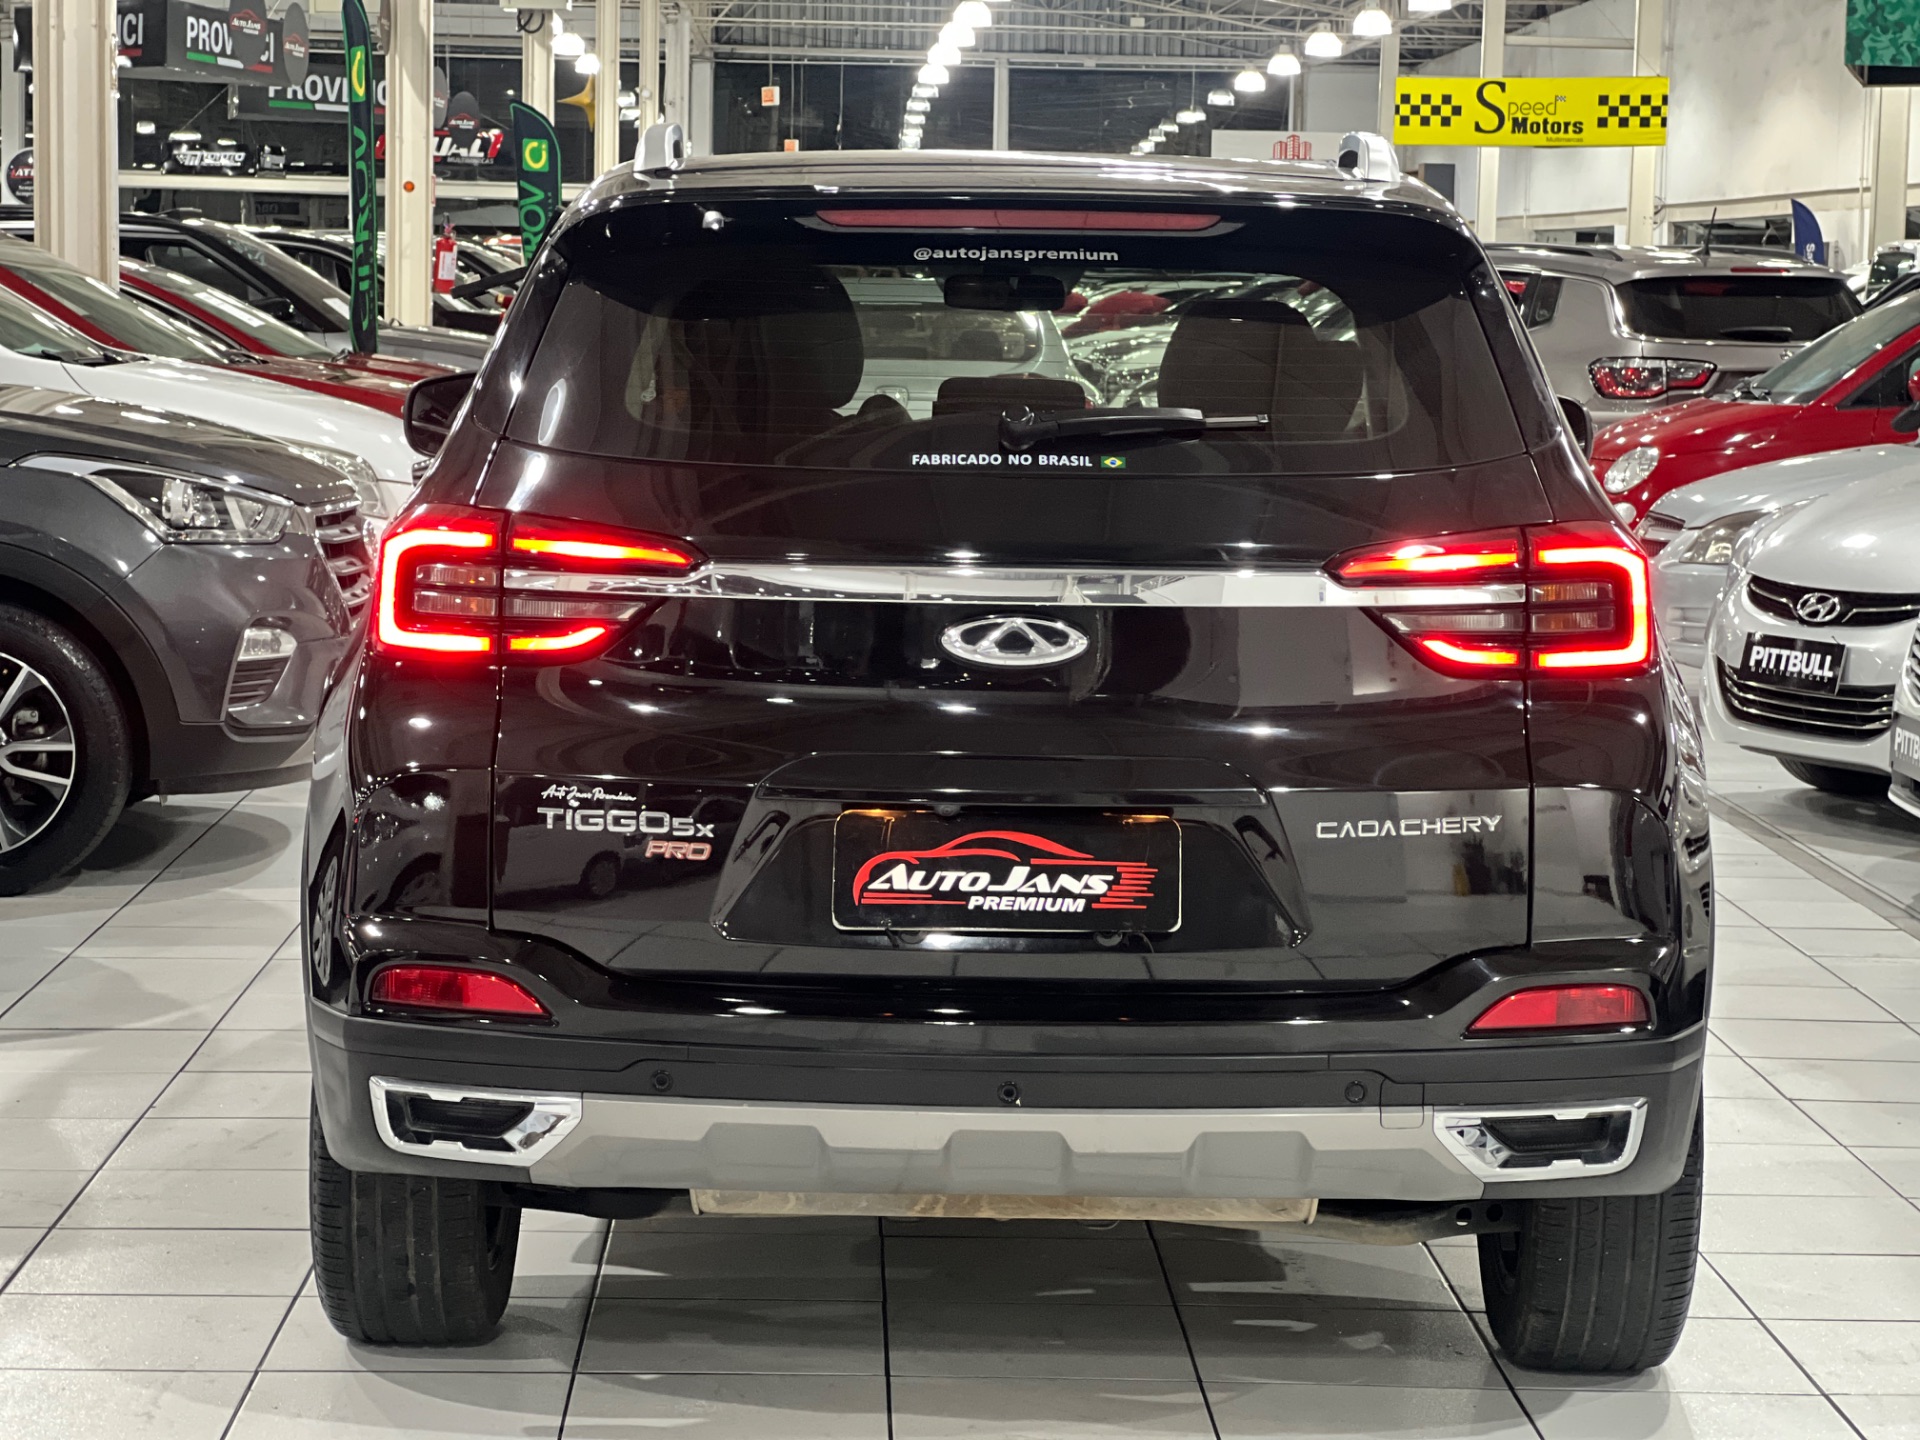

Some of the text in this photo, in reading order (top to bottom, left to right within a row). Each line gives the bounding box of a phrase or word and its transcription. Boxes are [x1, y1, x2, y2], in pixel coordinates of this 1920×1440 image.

[1474, 81, 1558, 134] Speed
[1511, 117, 1584, 135] Motors
[913, 247, 1119, 261] @autojanspremium
[911, 454, 1093, 467] FABRICADO NO BRASIL
[1749, 645, 1834, 678] PITTBULL
[645, 840, 712, 861] PRO
[967, 895, 1086, 912] PREMIUM
